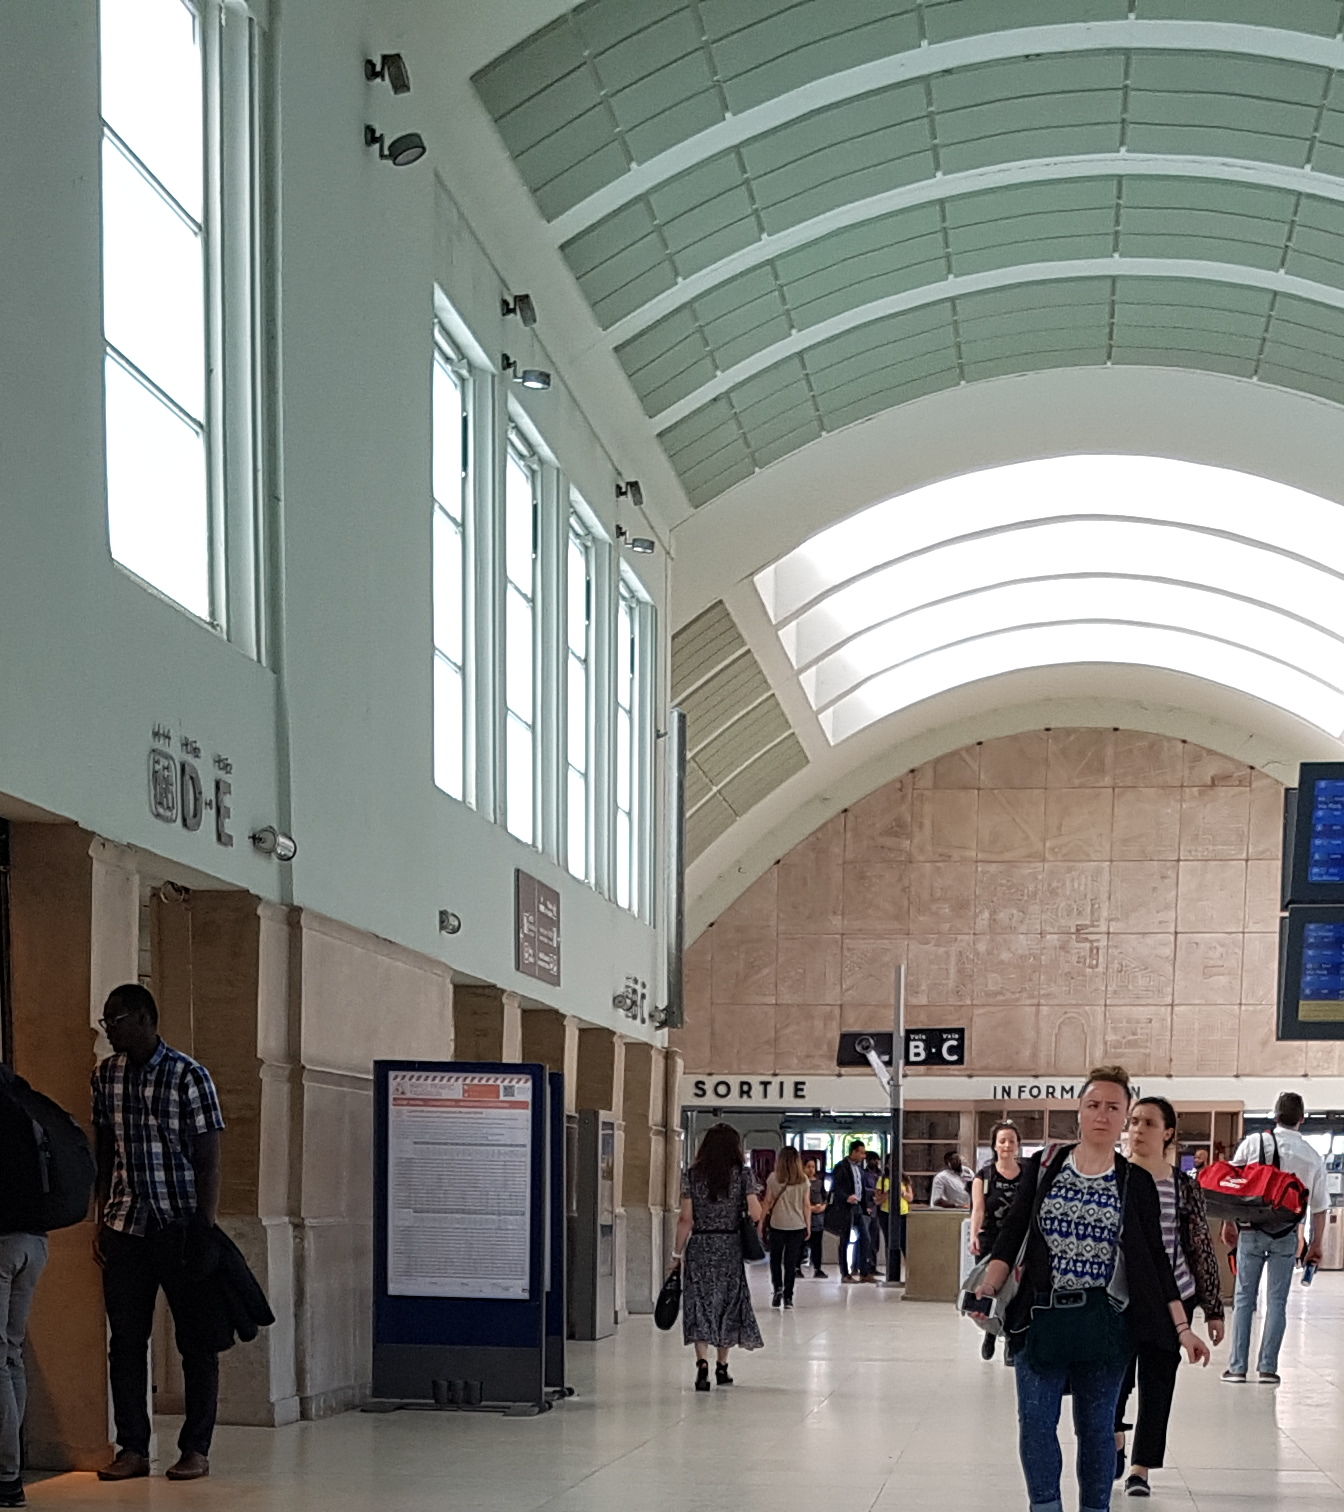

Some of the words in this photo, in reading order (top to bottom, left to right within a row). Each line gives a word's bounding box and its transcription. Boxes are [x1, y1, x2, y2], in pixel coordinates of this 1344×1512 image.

[908, 1040, 927, 1062] B
[941, 1039, 959, 1061] C
[693, 1079, 807, 1100] SORTIE
[992, 1084, 1142, 1100] INFORMN
